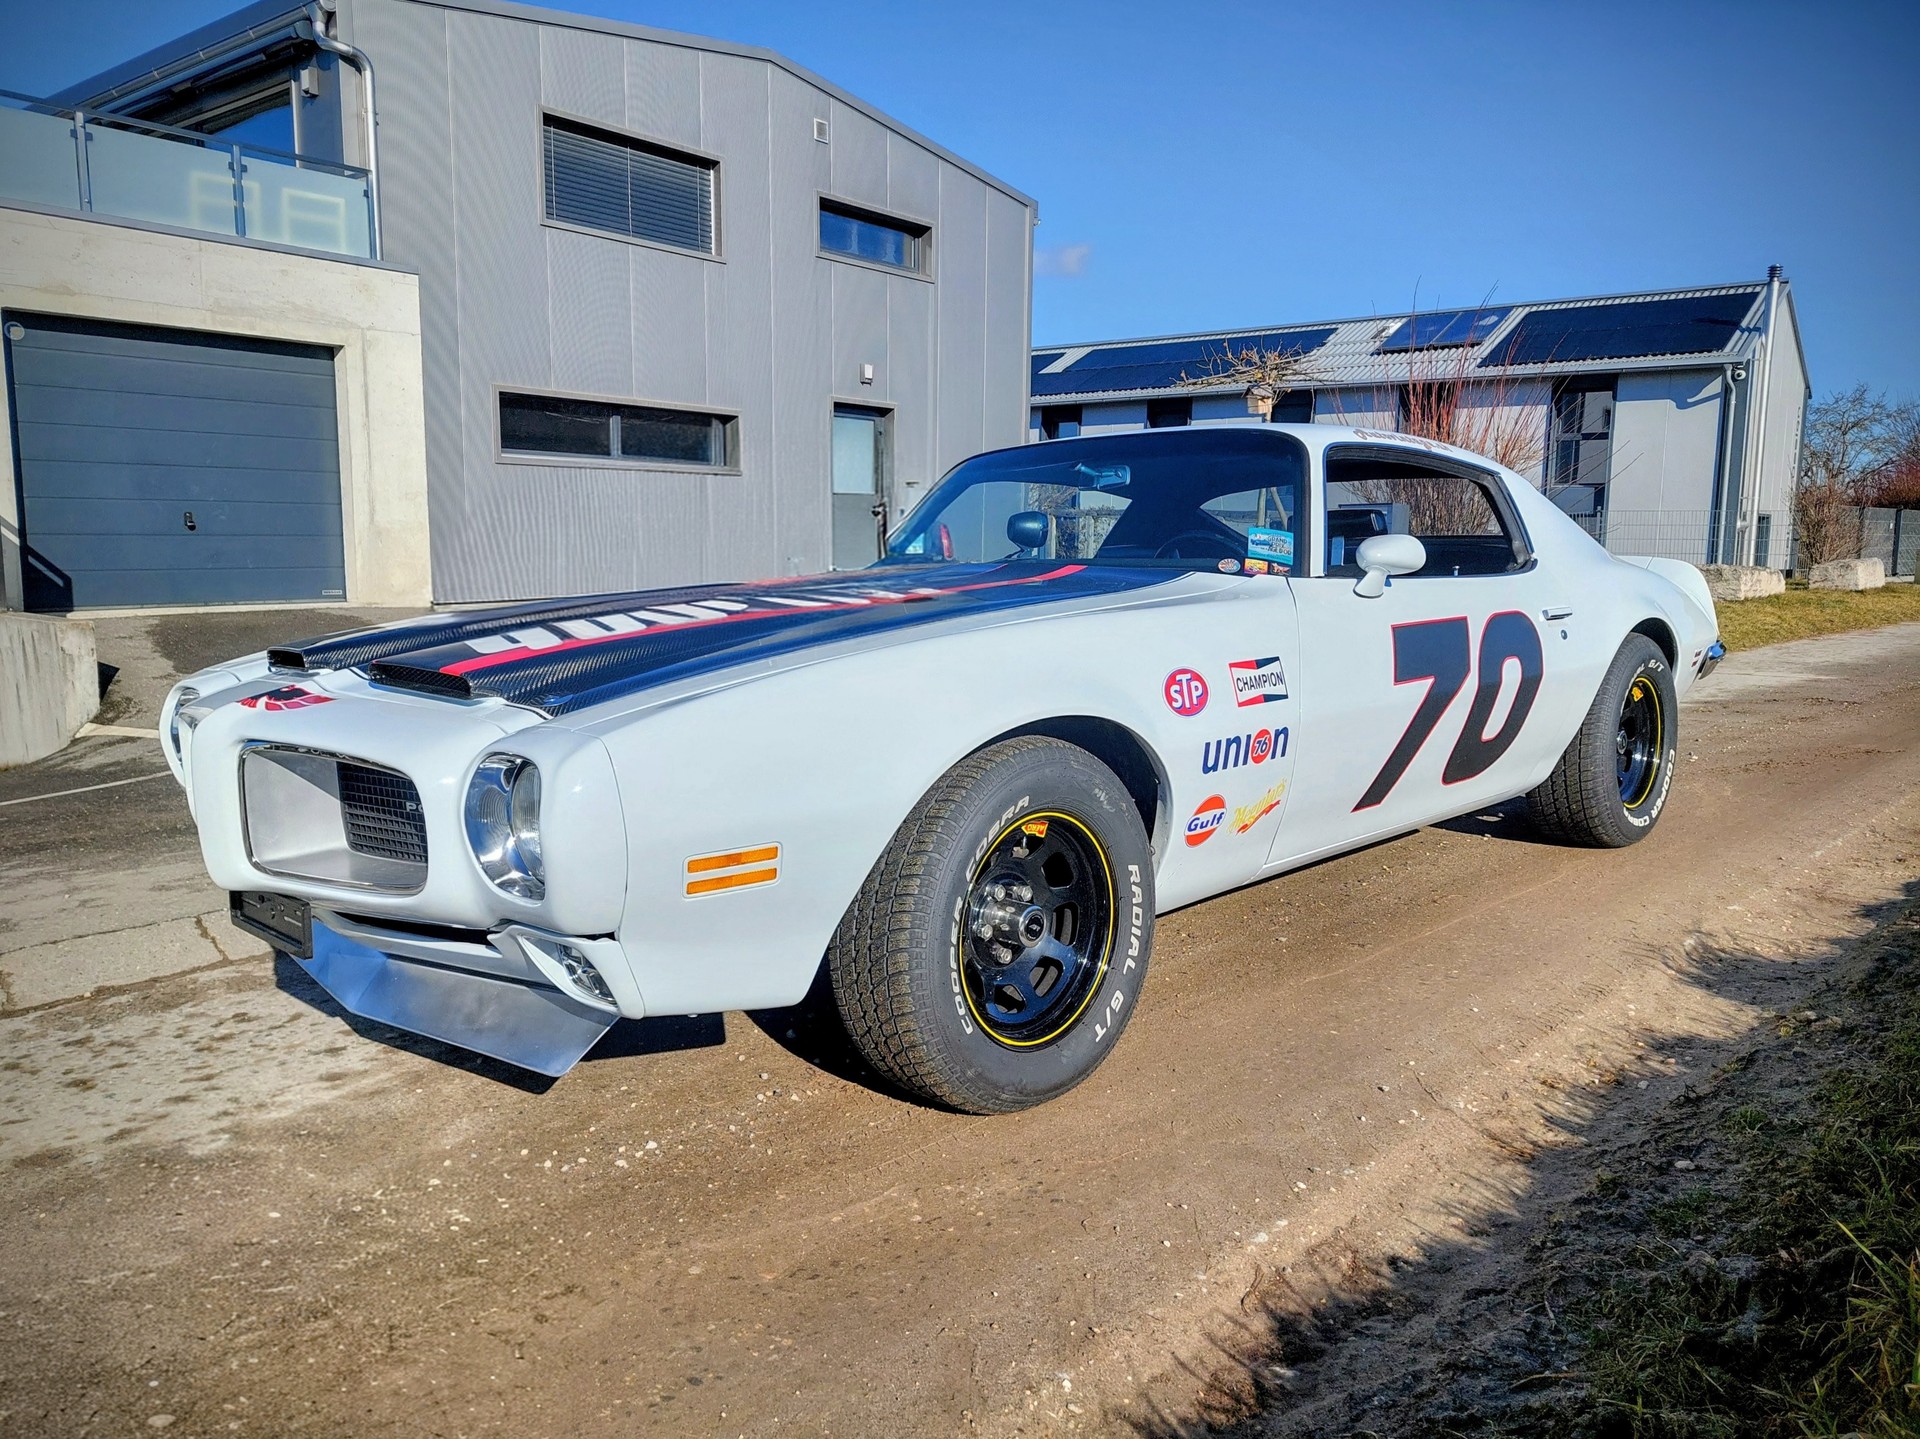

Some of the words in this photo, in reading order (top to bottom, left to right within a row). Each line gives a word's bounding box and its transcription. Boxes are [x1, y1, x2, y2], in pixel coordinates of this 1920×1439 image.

[1169, 672, 1204, 710] STP
[1236, 670, 1285, 693] CHAMPION
[1350, 609, 1544, 813] 70
[1253, 734, 1269, 755] 76
[1650, 748, 1676, 819] COOPER
[964, 795, 1031, 882] COBRA
[1186, 811, 1226, 833] Gulf
[1123, 864, 1143, 976] RADIAL
[950, 896, 974, 1035] COOPER
